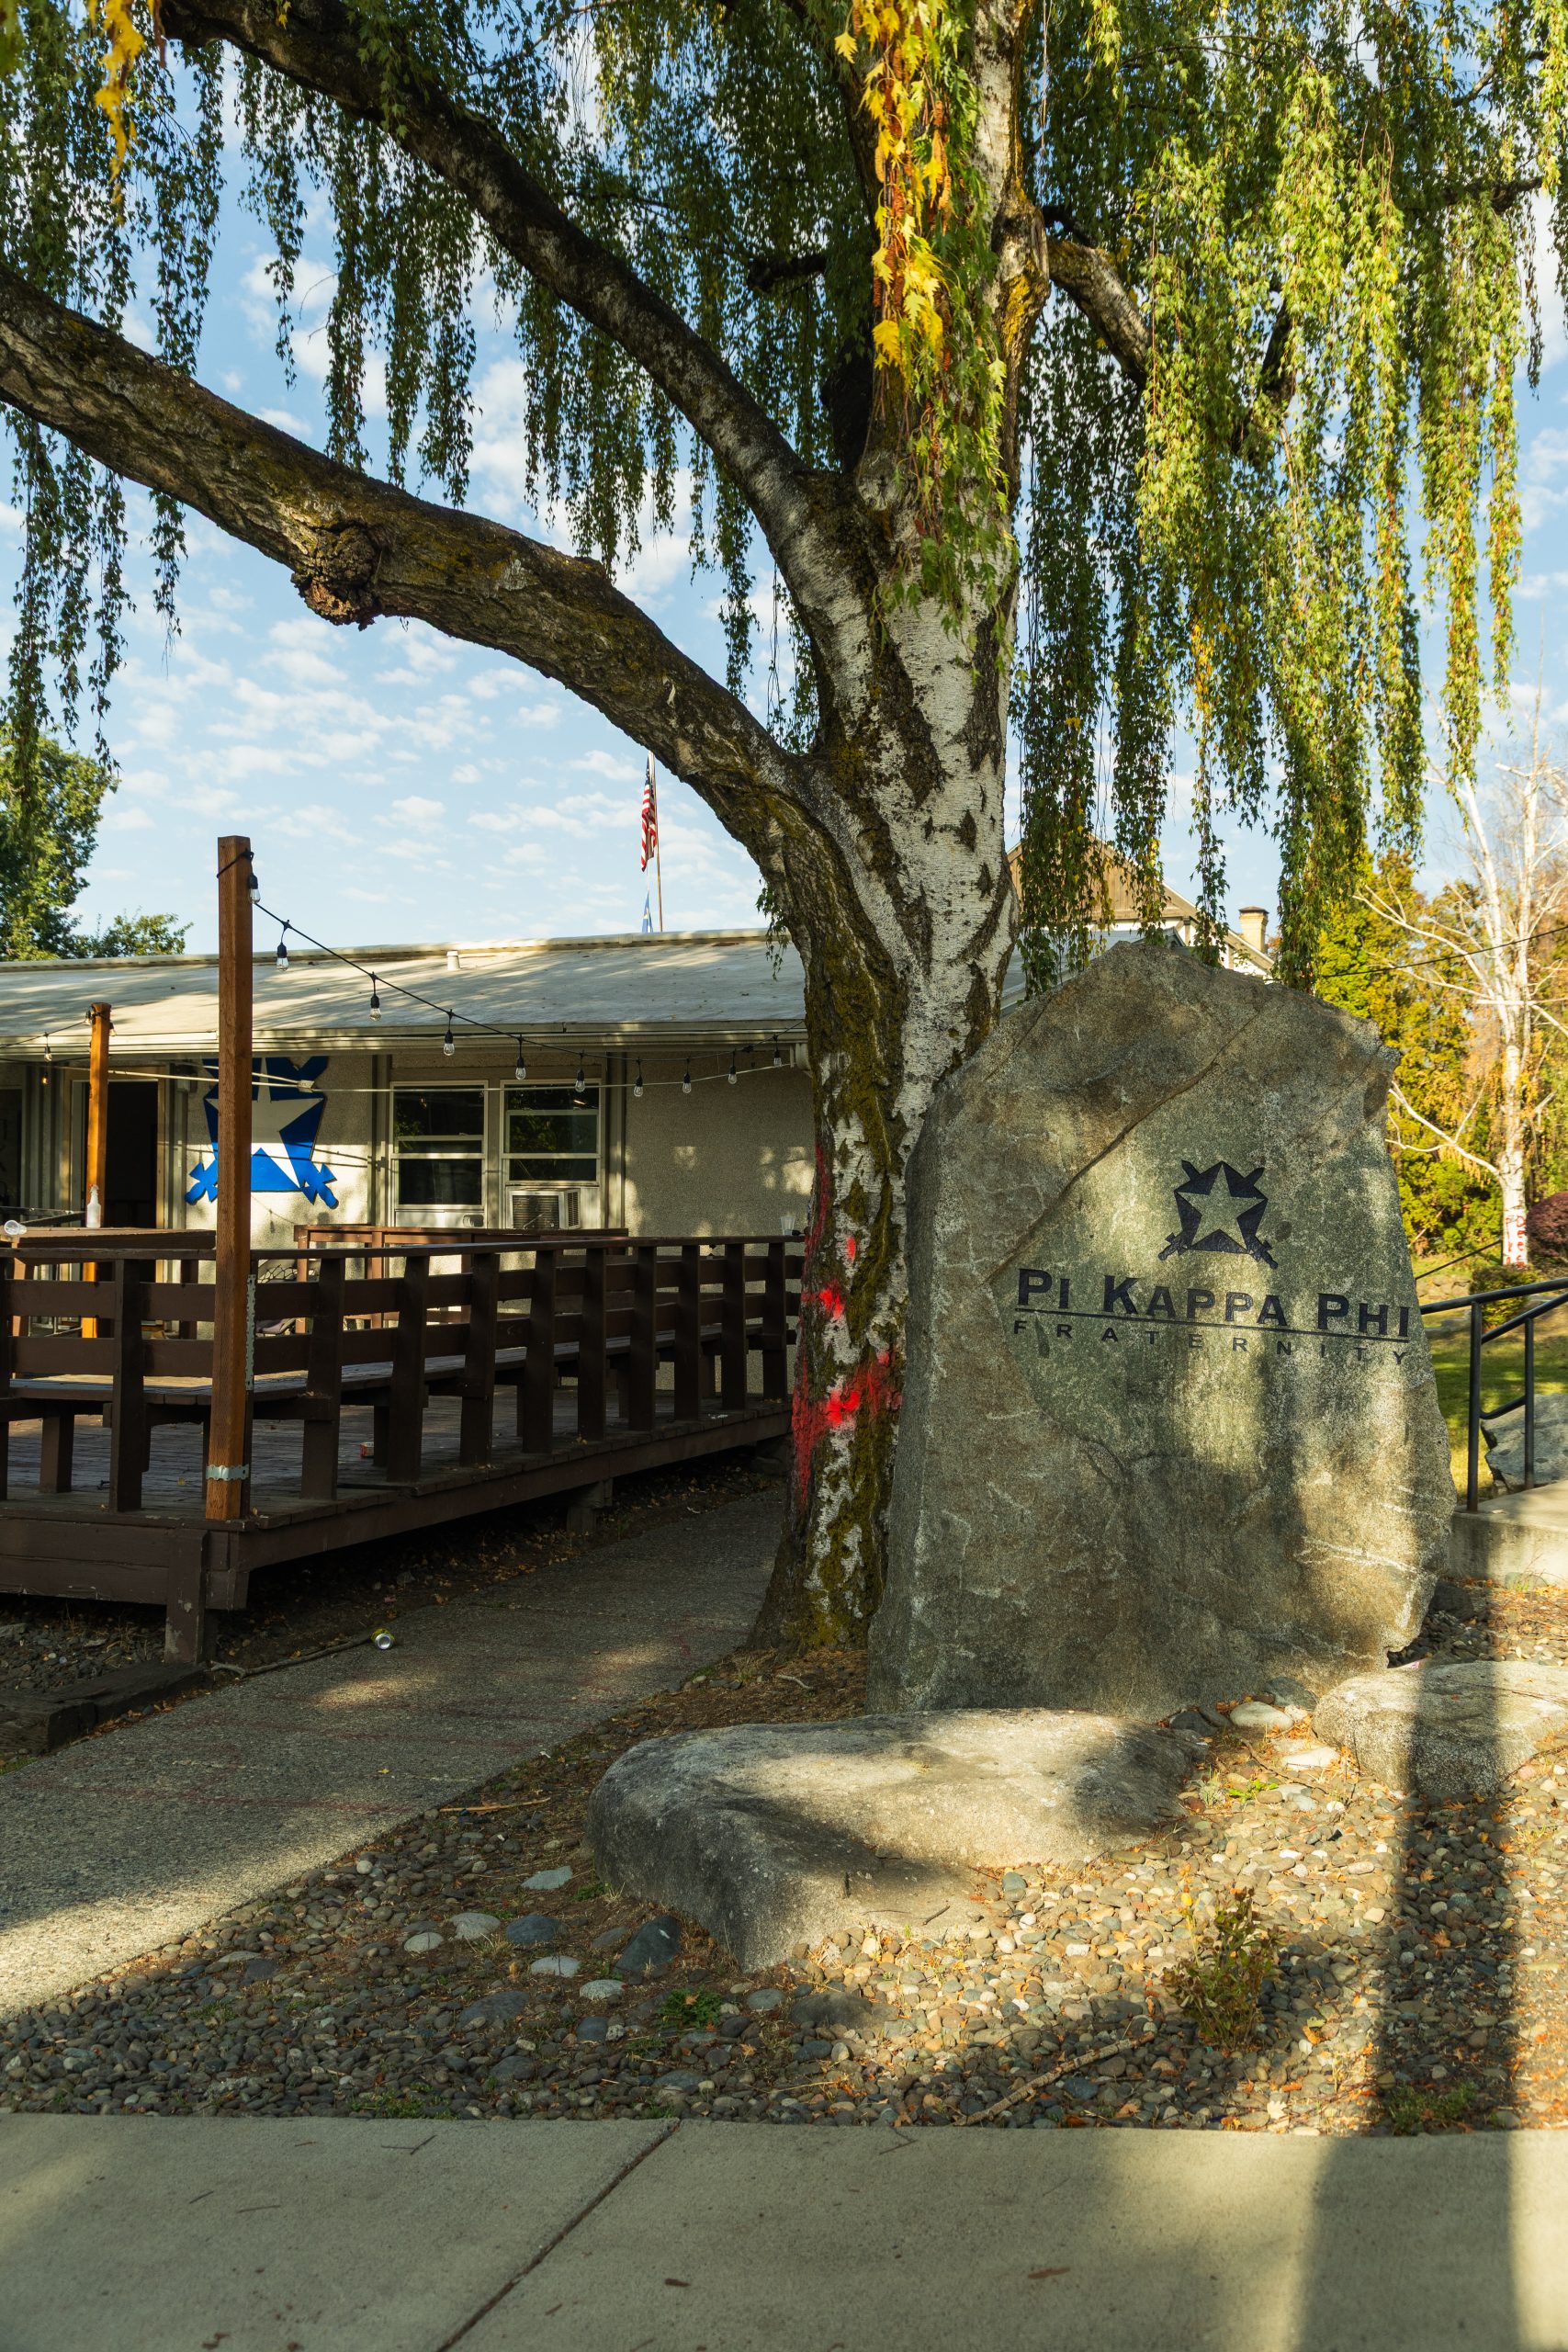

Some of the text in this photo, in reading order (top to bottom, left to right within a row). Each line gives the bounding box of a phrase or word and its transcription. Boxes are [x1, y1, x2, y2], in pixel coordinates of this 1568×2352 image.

[1017, 1268, 1411, 1338] PI KAPPA PHI
[1013, 1320, 1408, 1365] FRATERNITY
